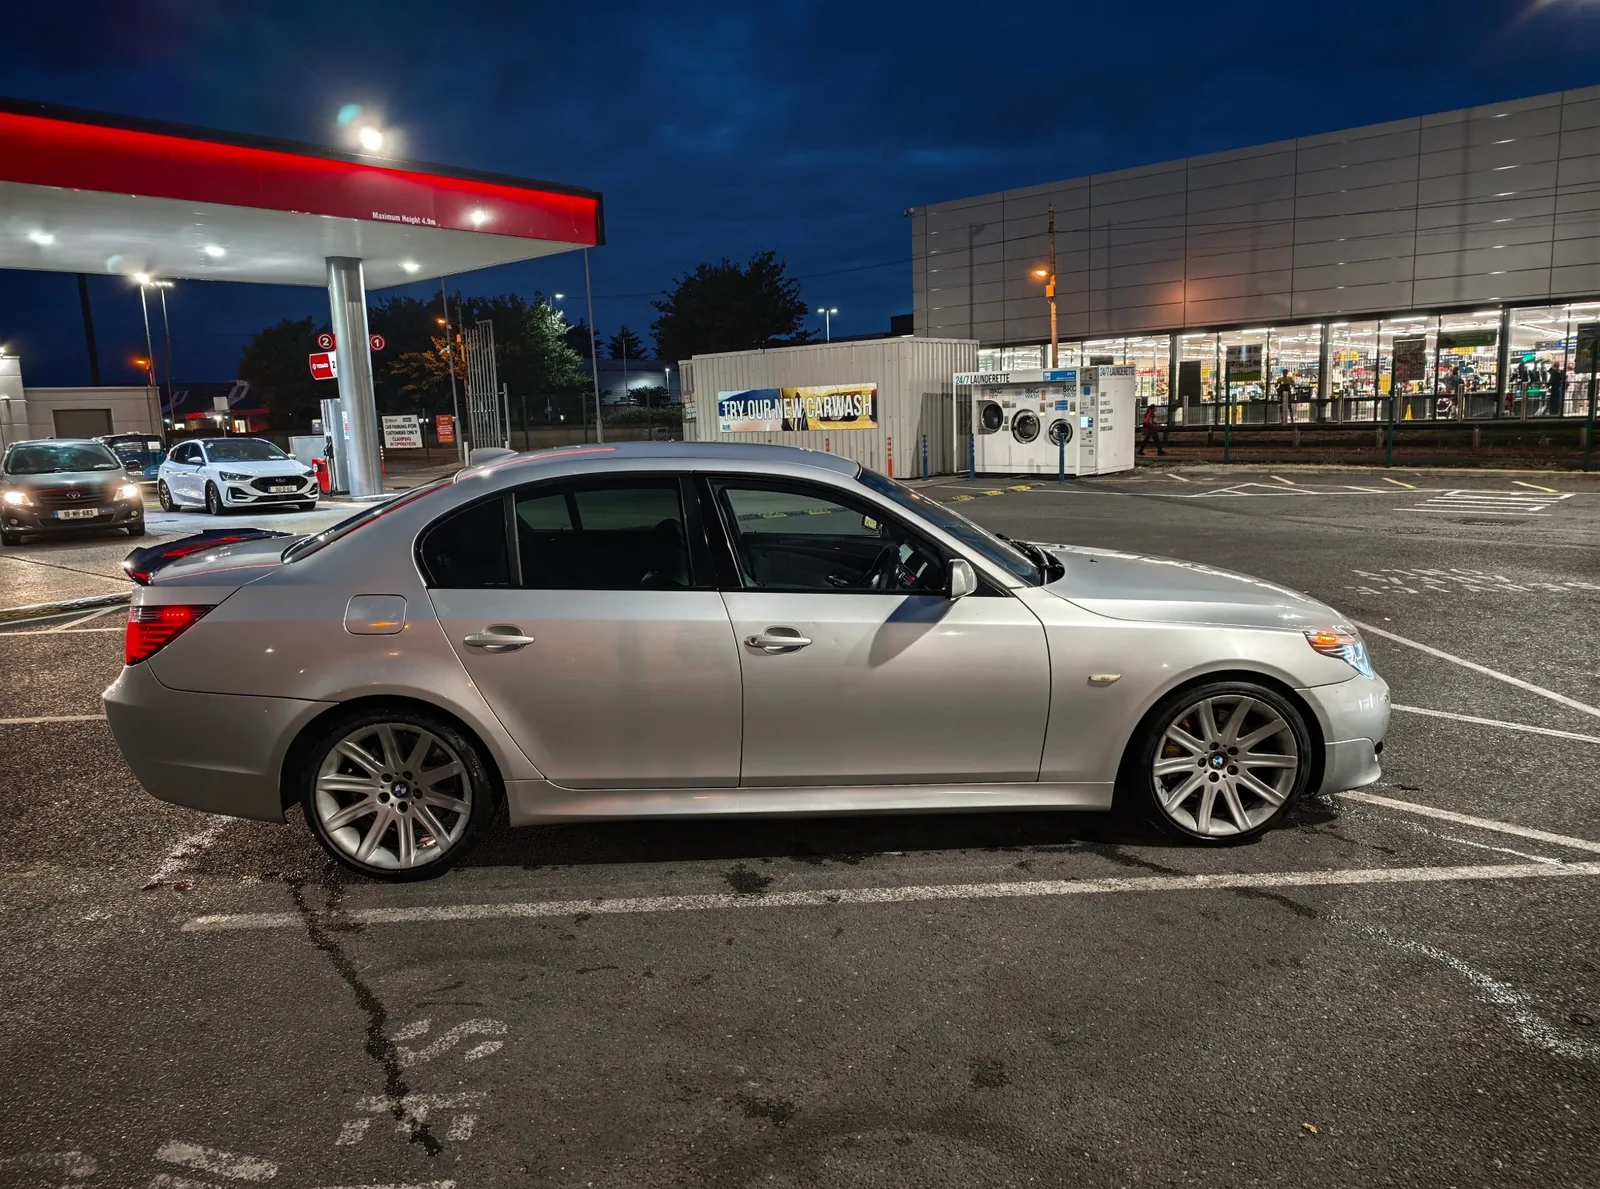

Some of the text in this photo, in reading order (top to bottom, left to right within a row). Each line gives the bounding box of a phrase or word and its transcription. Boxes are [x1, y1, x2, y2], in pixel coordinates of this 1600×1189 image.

[373, 212, 400, 221] Maximum
[402, 215, 420, 224] Height
[322, 338, 329, 346] 2
[1100, 366, 1135, 376] 24/7 LAUNDERETTE
[955, 373, 1010, 385] 24/7 LAUNDERETTE
[722, 394, 873, 421] TRY OUR NEW CARWASH
